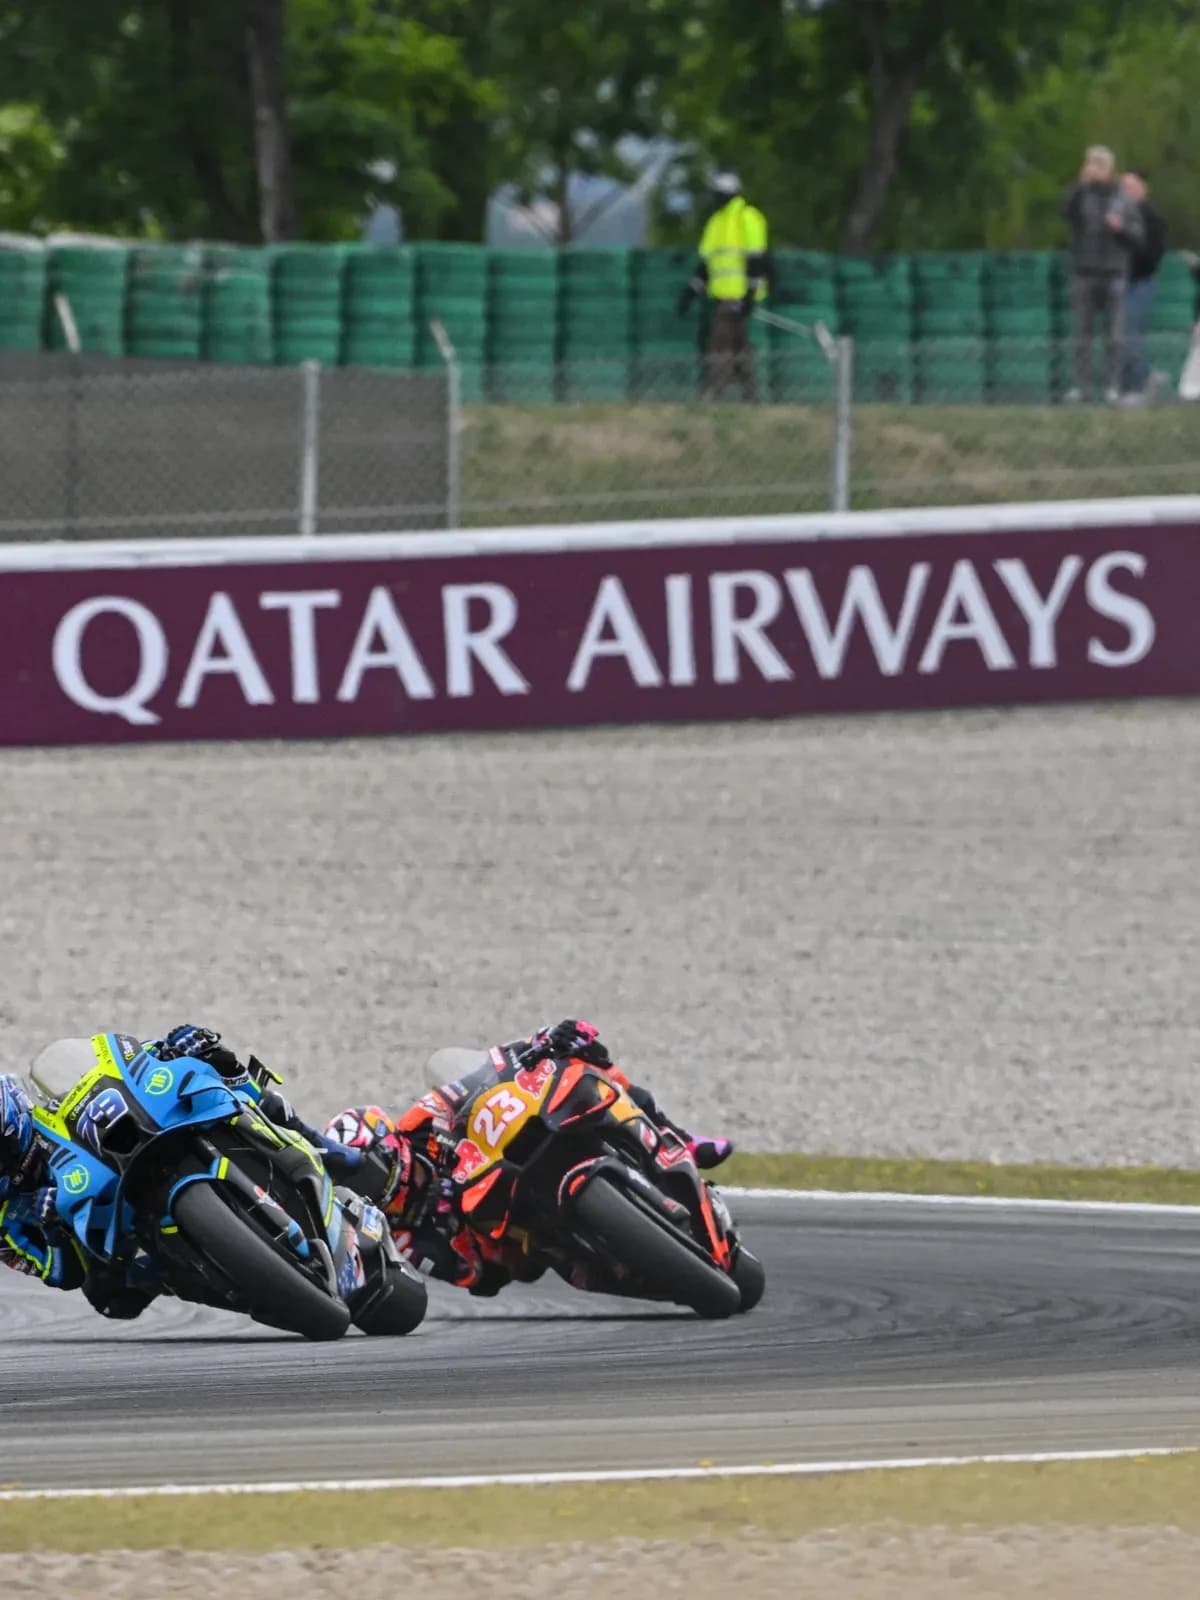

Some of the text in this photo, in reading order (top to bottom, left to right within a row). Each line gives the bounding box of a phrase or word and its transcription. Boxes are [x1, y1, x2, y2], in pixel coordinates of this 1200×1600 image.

[52, 550, 1156, 725] QATAR AIRWAYS
[473, 1089, 527, 1148] 23
